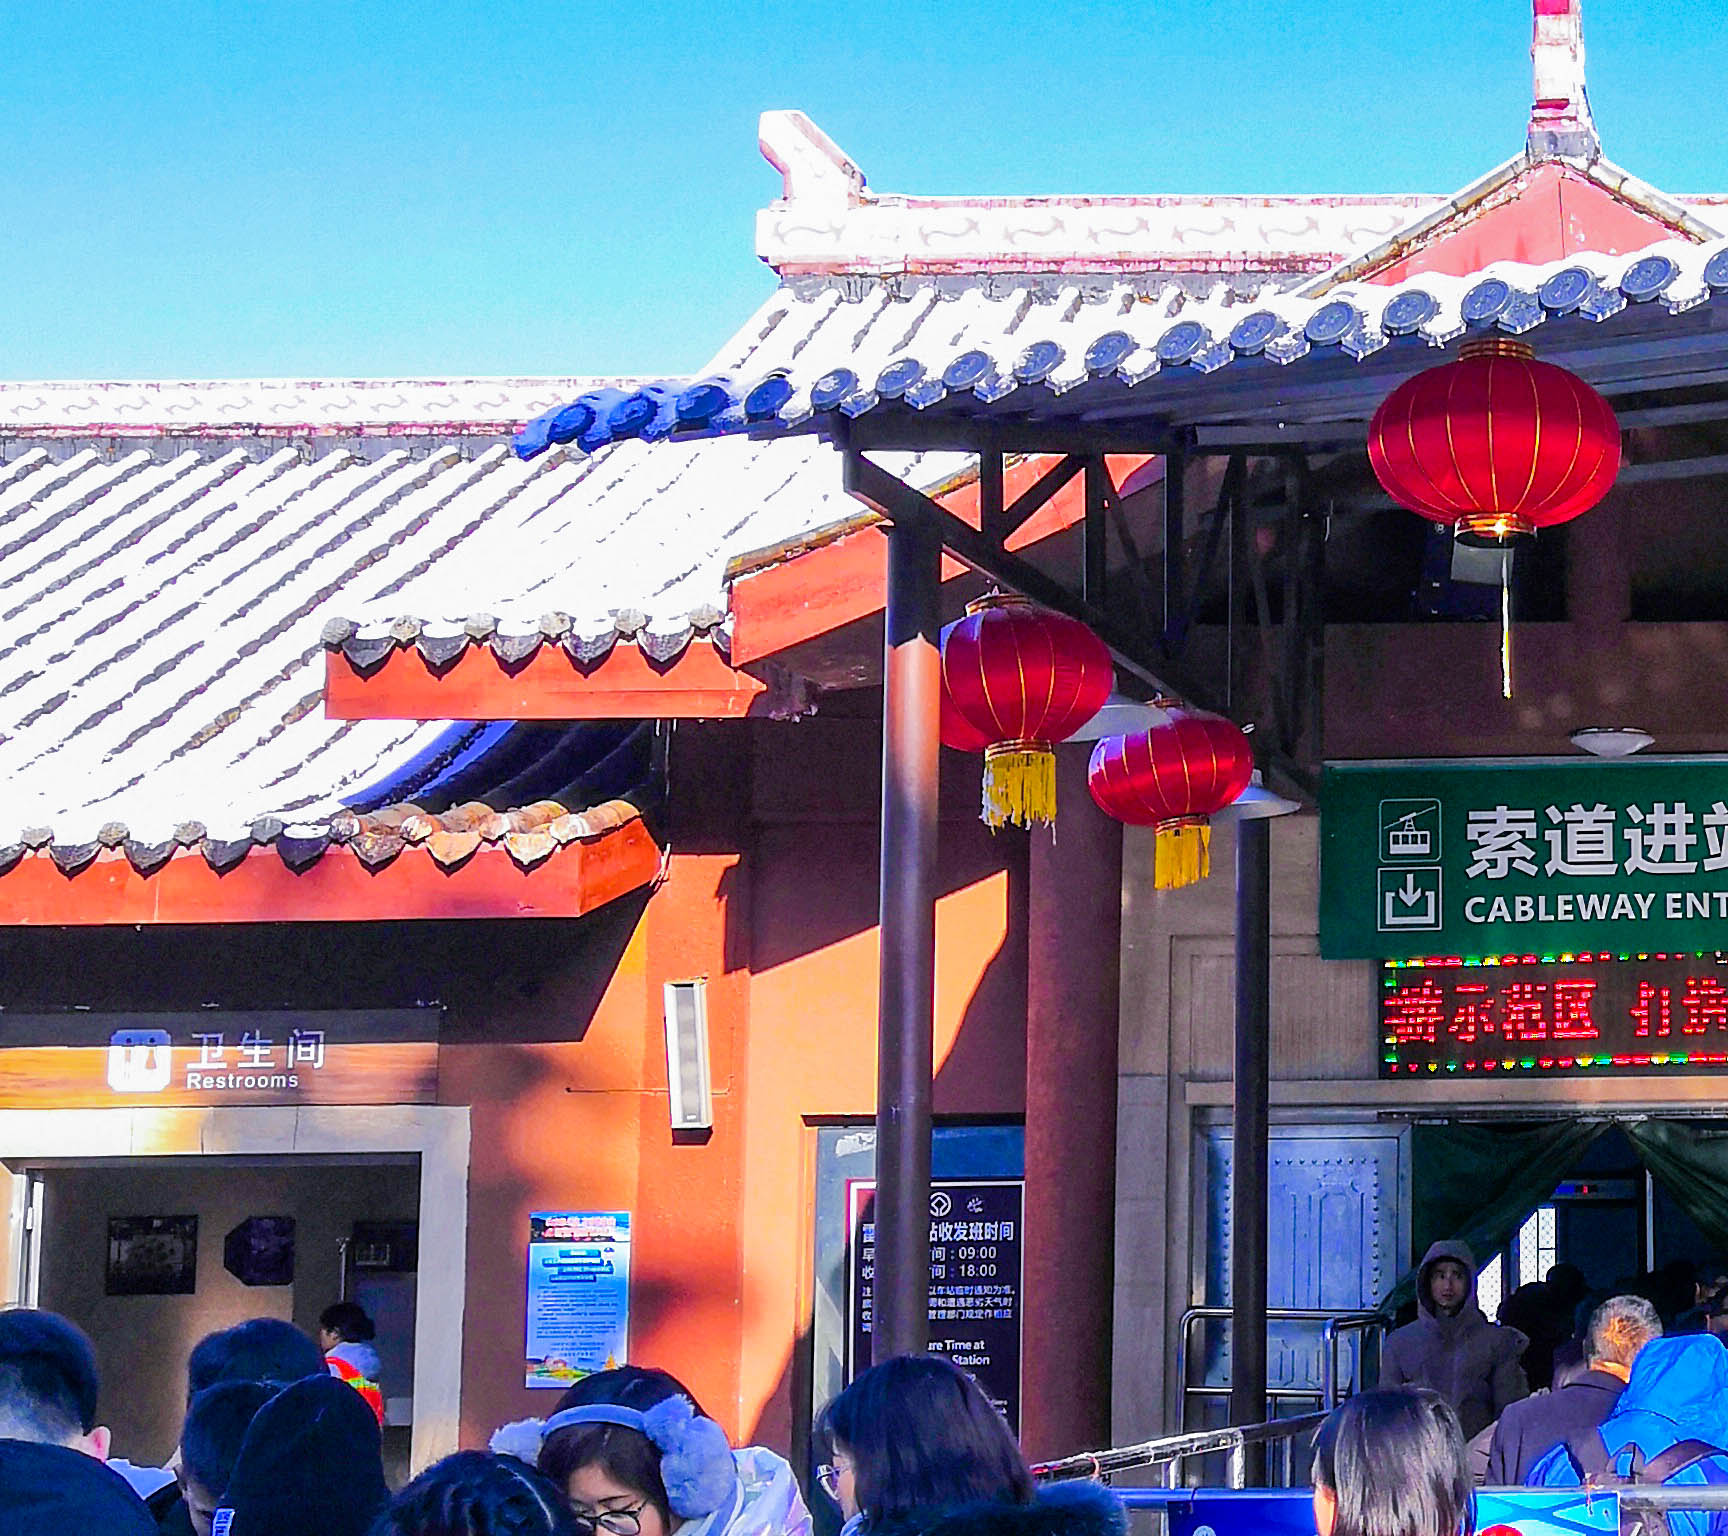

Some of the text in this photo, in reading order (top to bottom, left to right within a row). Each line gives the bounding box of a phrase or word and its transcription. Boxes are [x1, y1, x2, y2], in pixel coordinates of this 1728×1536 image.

[1464, 892, 1656, 924] CABLEWAY
[186, 1027, 327, 1070] 卫生间
[186, 1070, 299, 1091] Restrooms
[945, 1340, 972, 1351] Time
